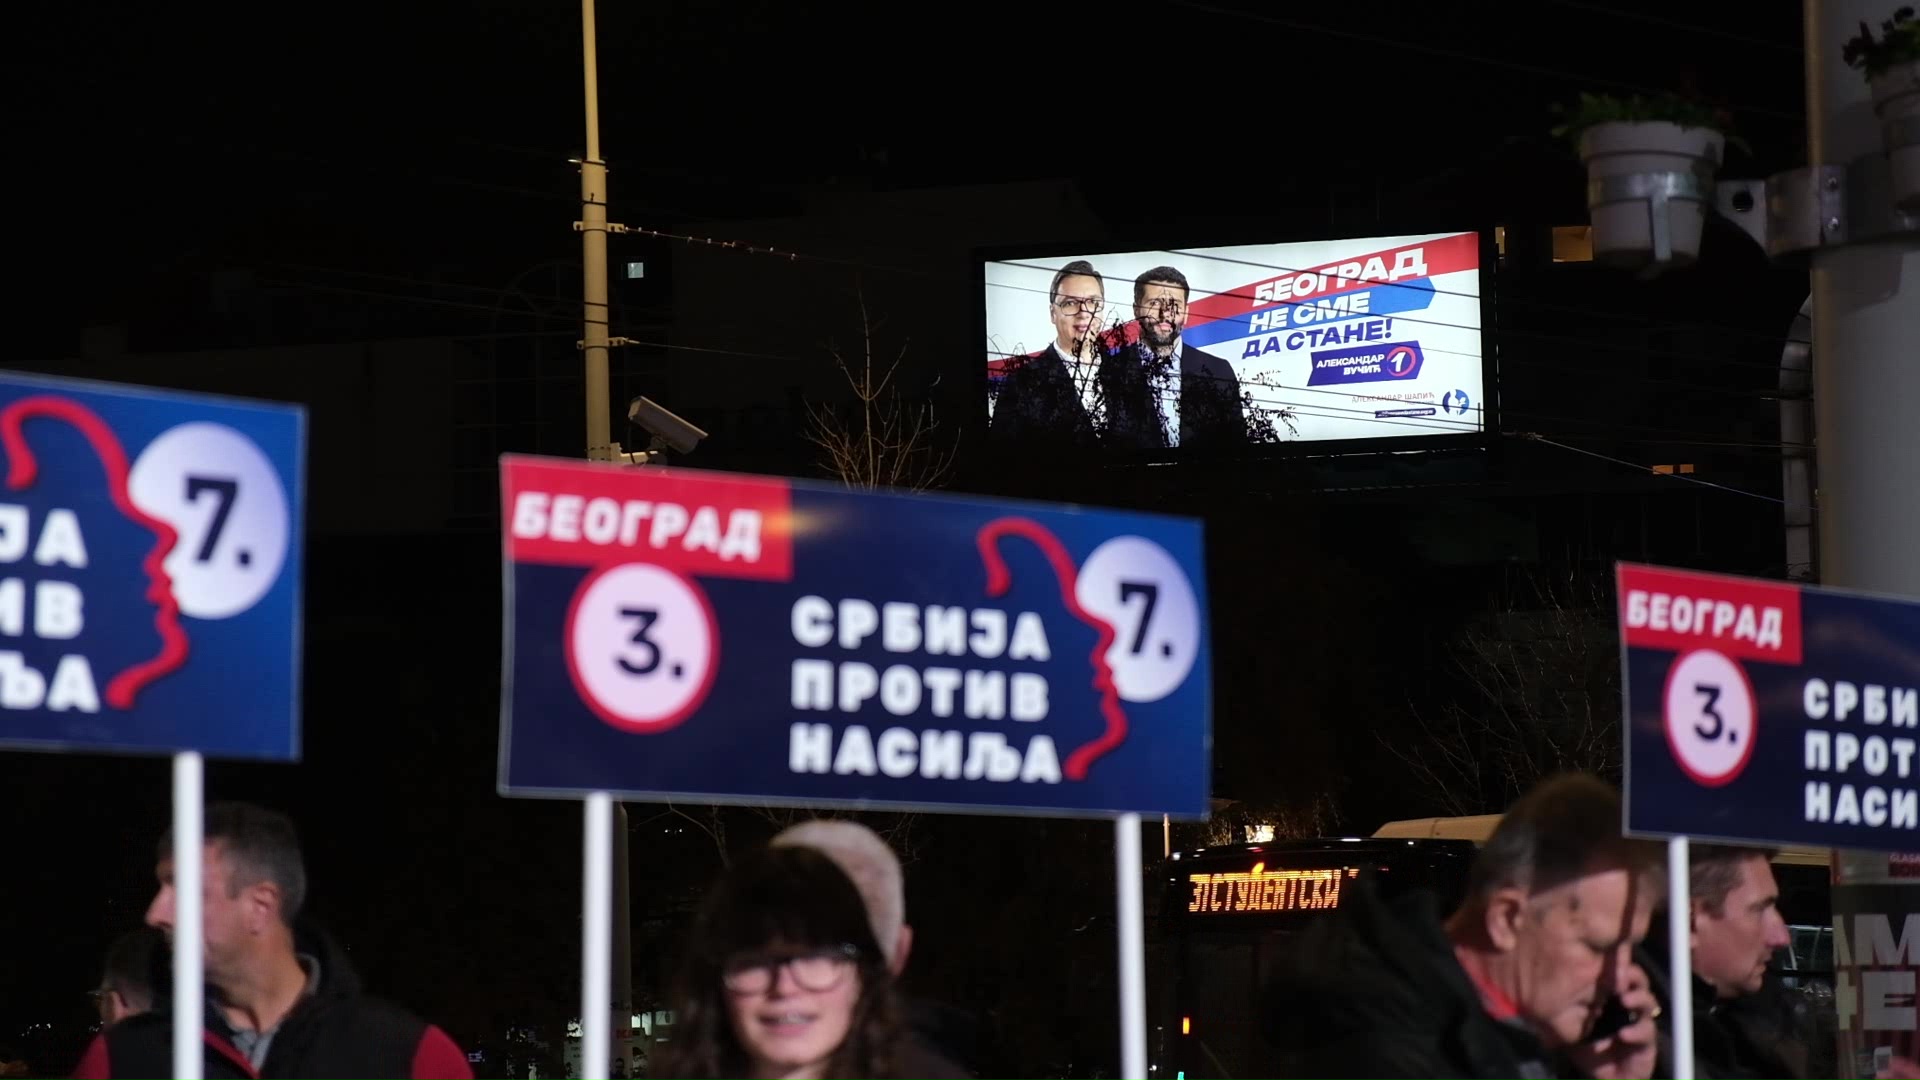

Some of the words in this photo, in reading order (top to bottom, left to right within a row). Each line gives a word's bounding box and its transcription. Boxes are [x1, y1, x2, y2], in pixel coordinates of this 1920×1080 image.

[1252, 247, 1427, 308] БЕОГРАД
[1242, 337, 1281, 360] ДА
[1286, 318, 1393, 350] СТАНЕ!
[1249, 307, 1289, 334] НЕ
[1292, 291, 1371, 325] СМЕ
[1316, 354, 1385, 369] АЛЕКСАНДАР
[1343, 365, 1382, 376] ВУЧИЋ
[1390, 351, 1407, 373] 1
[186, 476, 251, 566] 7.
[512, 490, 763, 563] БЕОГРАД
[618, 608, 683, 676] 3.
[790, 594, 1052, 662] СРБИЈА
[1119, 582, 1173, 657] 7.
[1626, 589, 1783, 651] БЕОГРАД
[790, 658, 1050, 722] ПРОТИВ
[1694, 684, 1737, 743] 3.
[1803, 677, 1919, 729] СРБИ
[788, 721, 1063, 785] НАСИЉА
[1804, 781, 1919, 829] НАСИ
